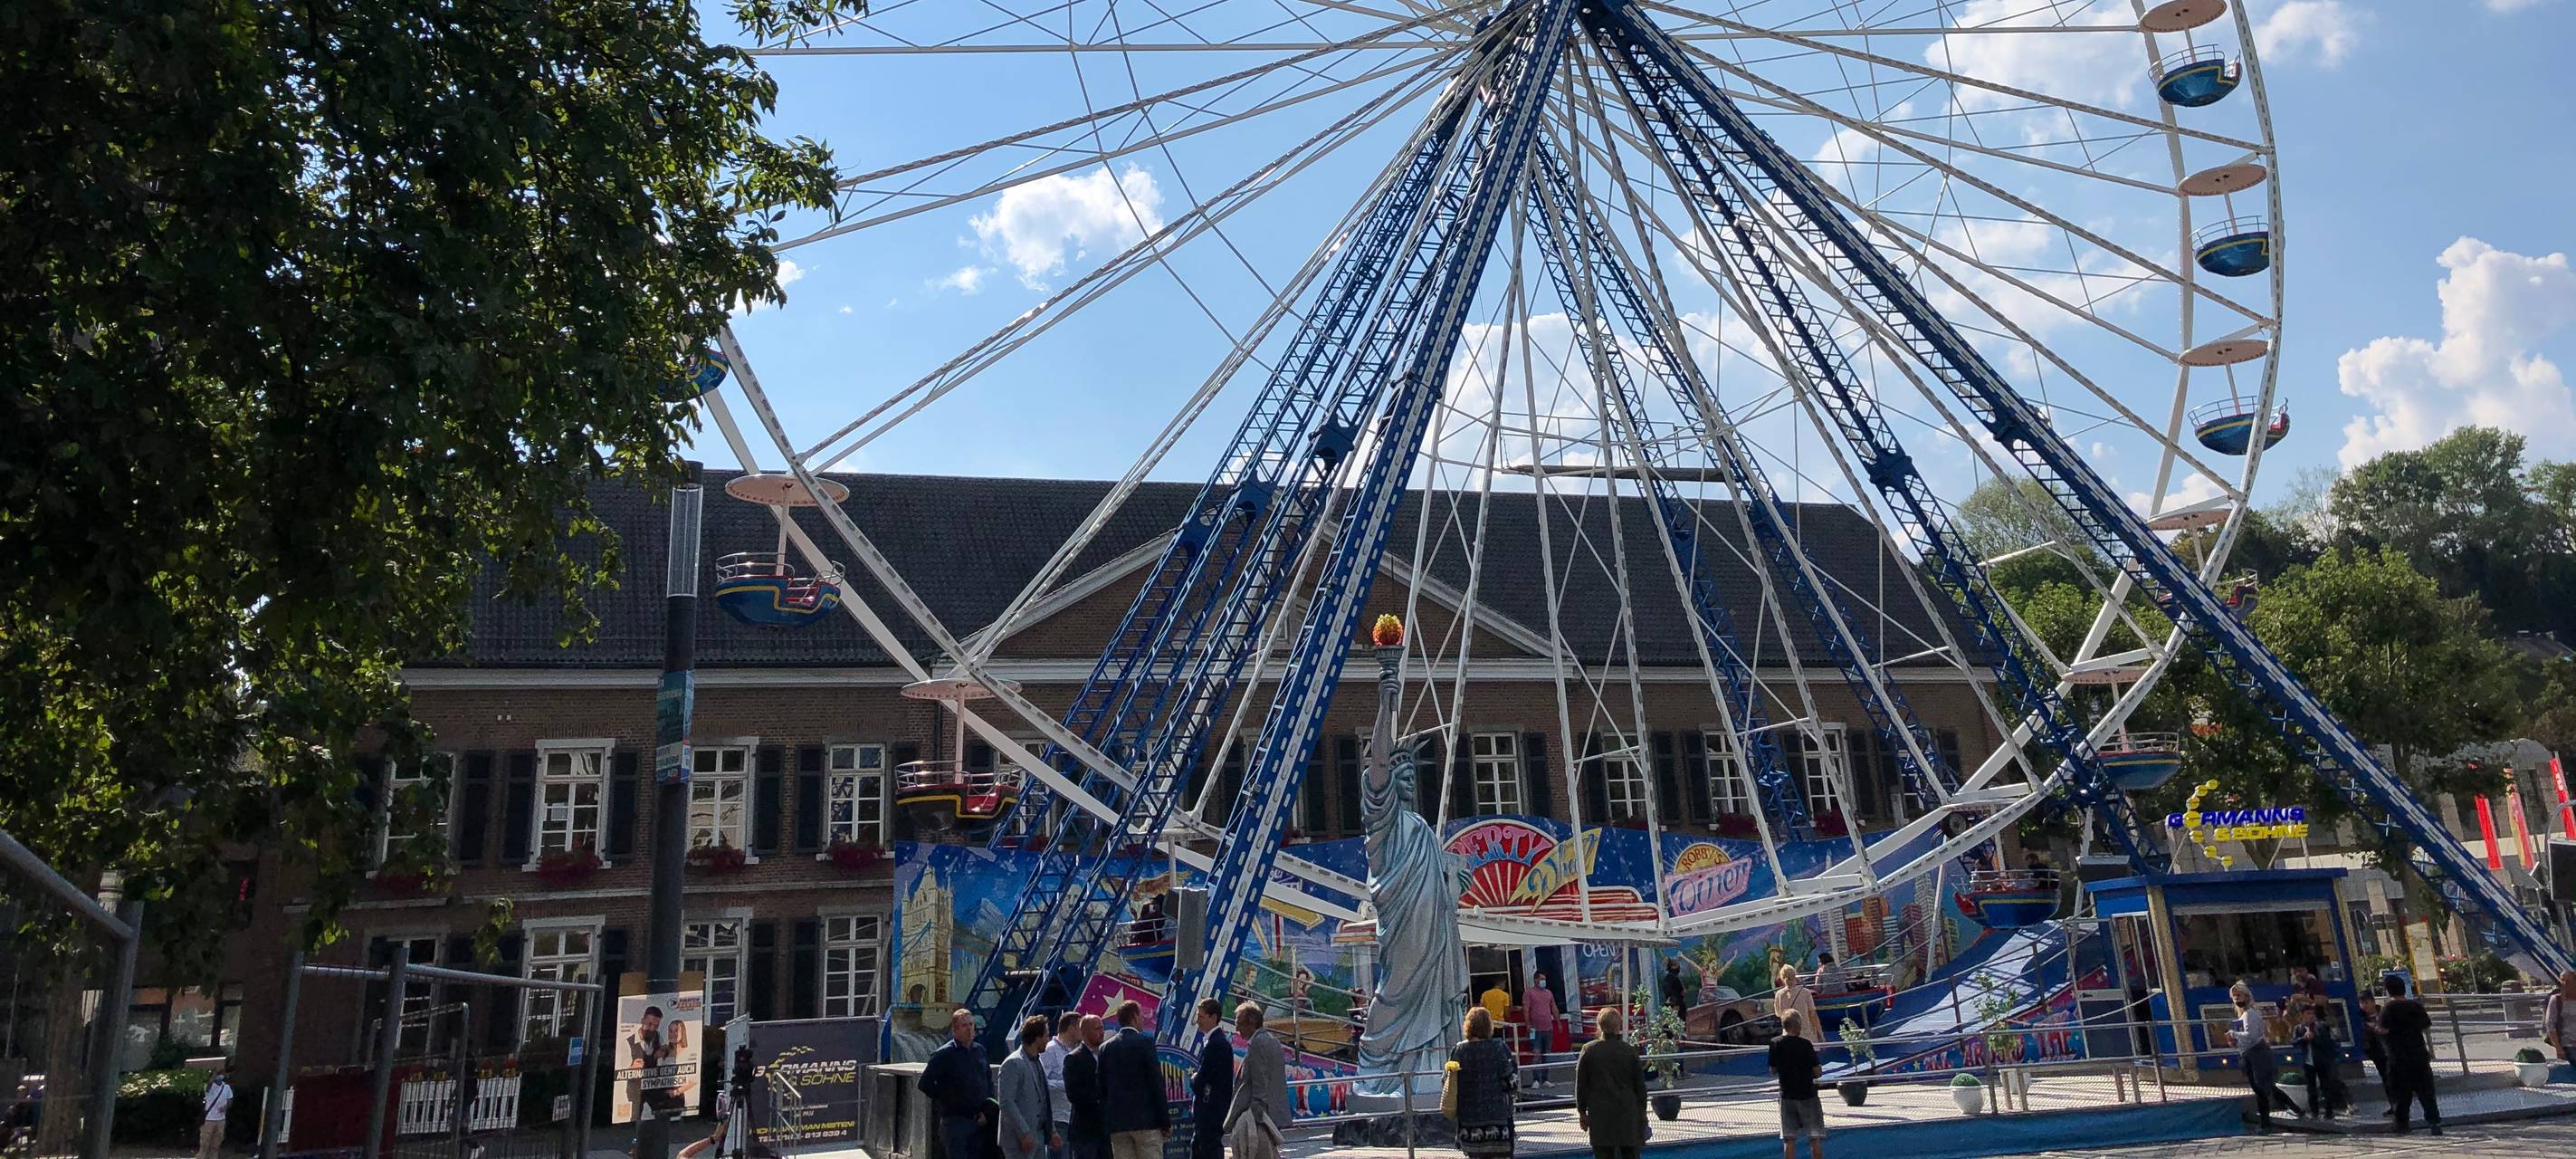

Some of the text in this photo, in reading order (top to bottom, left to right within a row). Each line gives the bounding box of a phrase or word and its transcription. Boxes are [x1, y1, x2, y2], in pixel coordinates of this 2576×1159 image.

[1681, 847, 1723, 869] ROBBY'S
[1670, 861, 1748, 912] Diner
[1582, 943, 1616, 958] OPEN
[616, 1064, 695, 1080] ALTERNATIVE GEHT AUCH
[800, 1070, 856, 1087] SÖHNE
[643, 1076, 687, 1088] SYMPATHISCH
